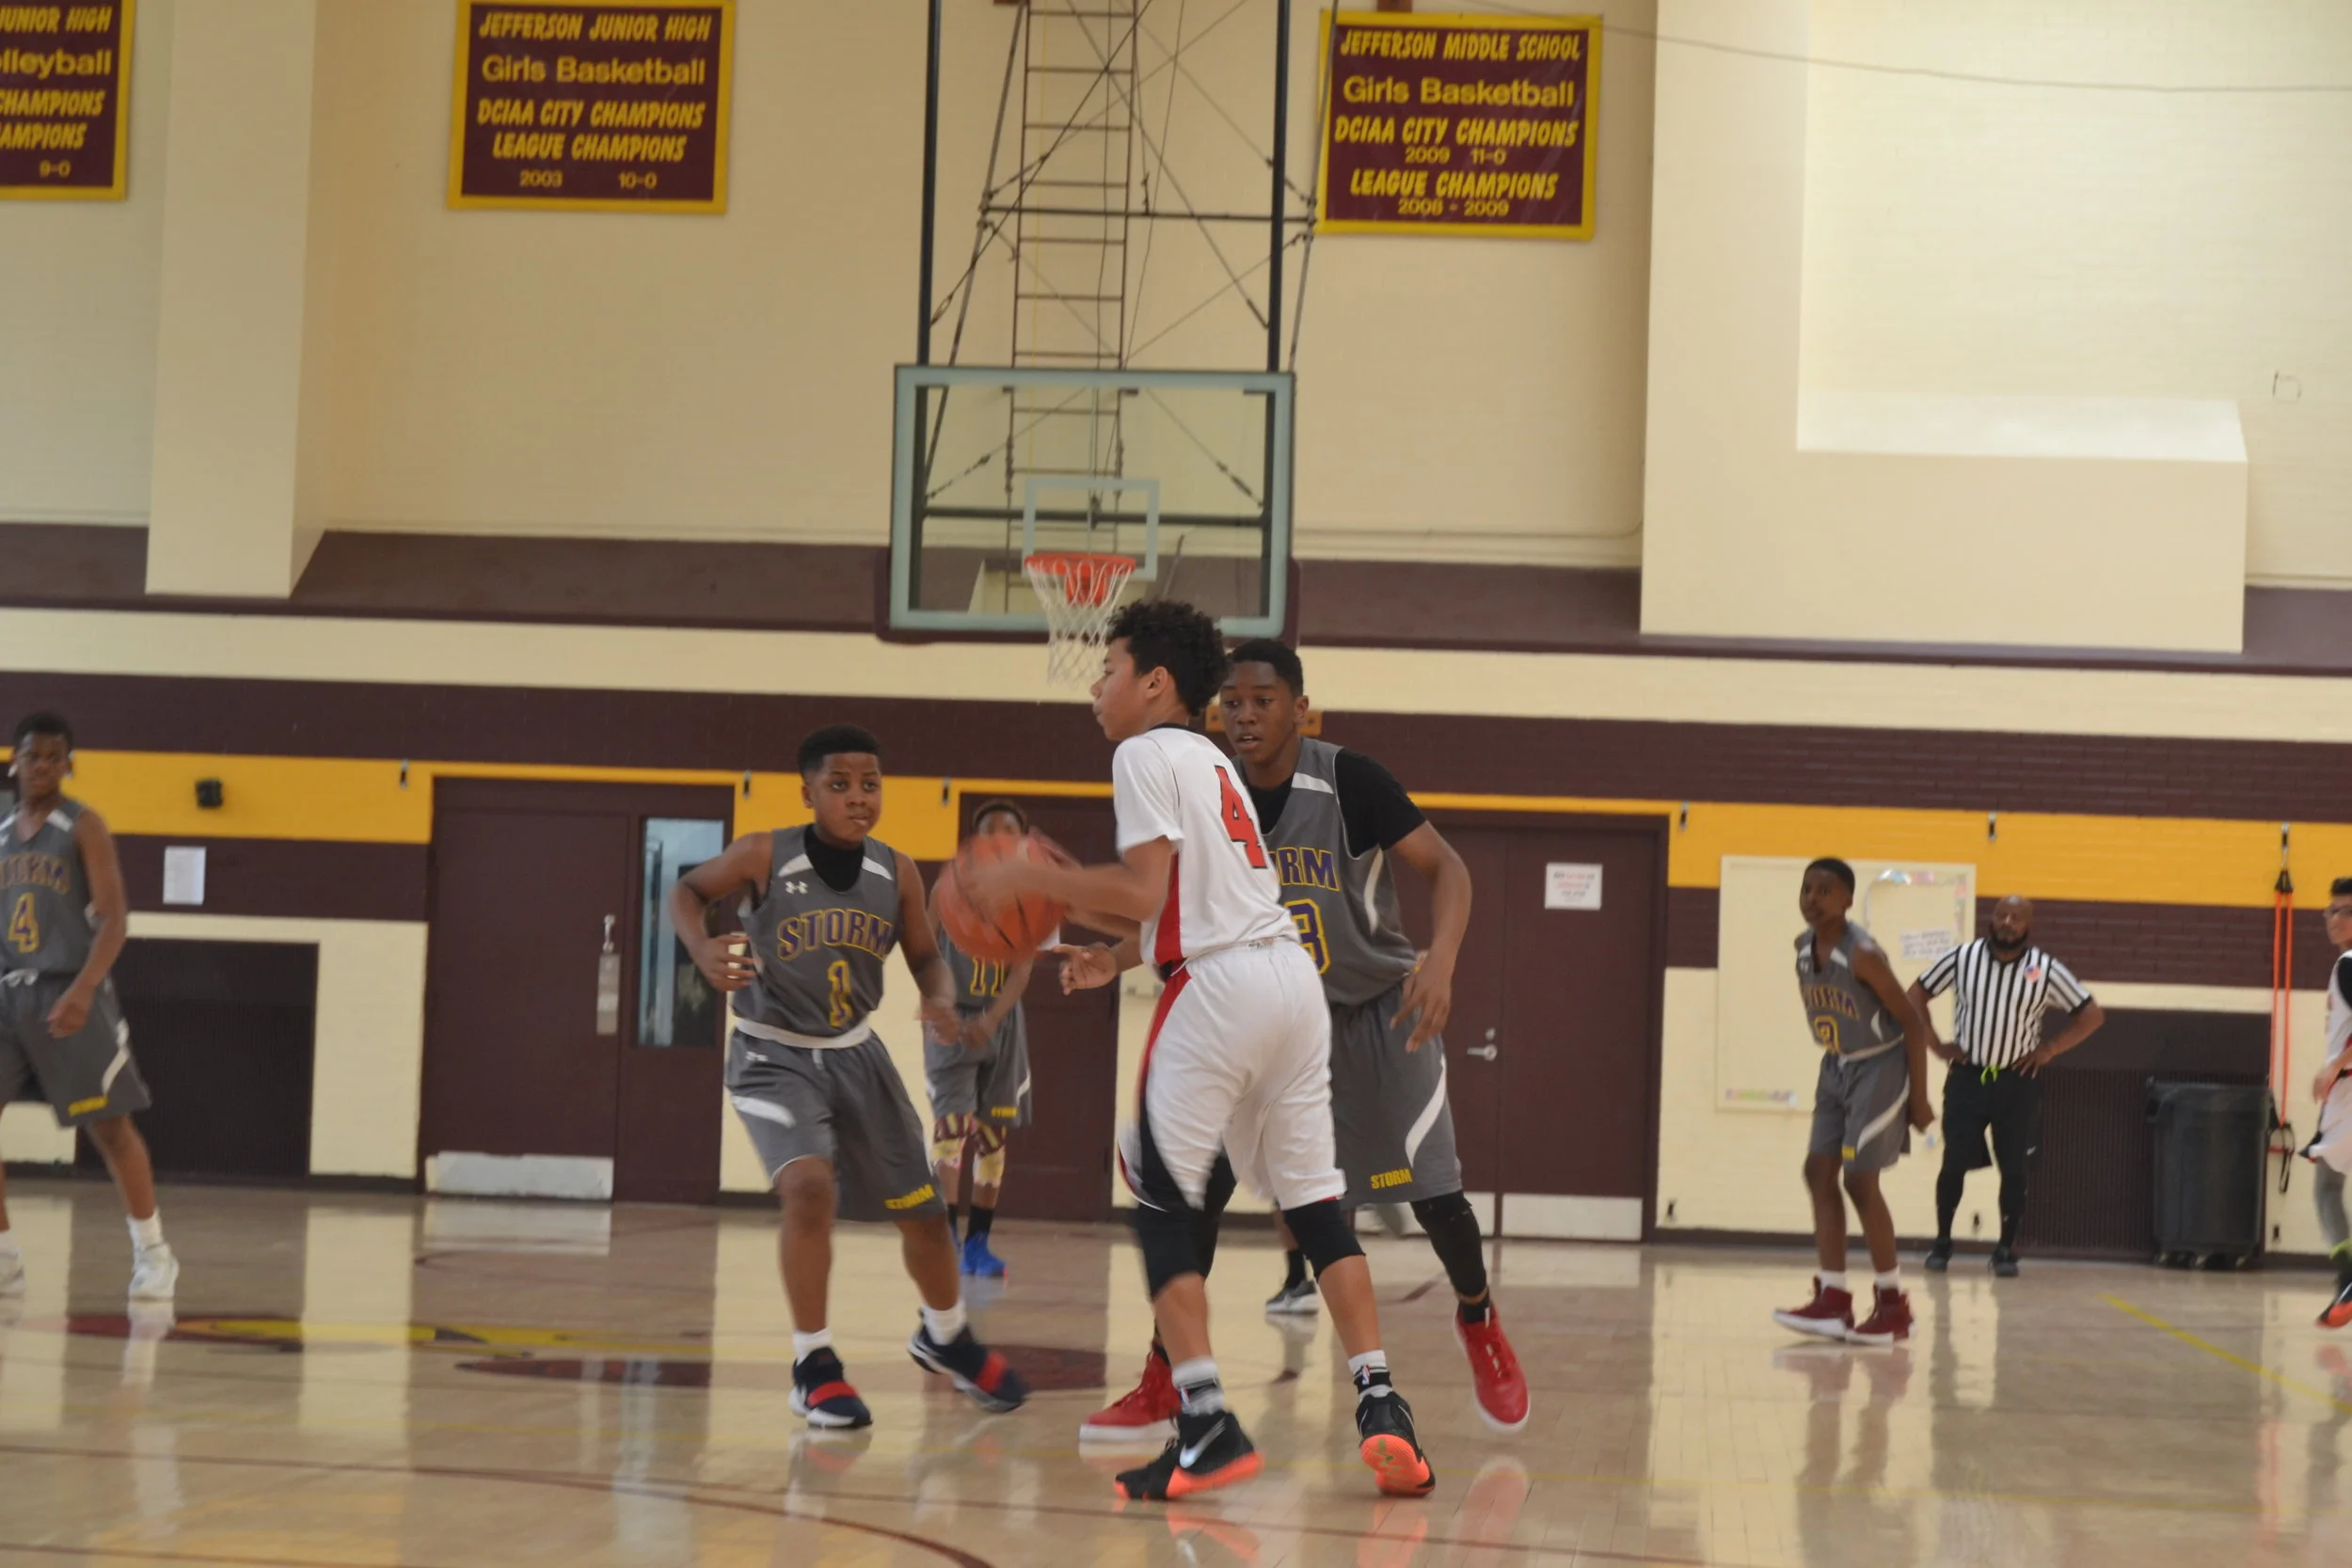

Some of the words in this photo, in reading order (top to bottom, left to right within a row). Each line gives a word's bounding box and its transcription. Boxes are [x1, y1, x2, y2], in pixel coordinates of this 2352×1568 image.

[66, 6, 113, 33] HIGH
[479, 12, 583, 40] JEFFERSON
[589, 14, 659, 42] JUNIOR
[664, 15, 712, 41] HIGH
[1340, 29, 1438, 59] JEFFERSON
[1442, 32, 1510, 60] MIDDLE
[1516, 34, 1581, 61] SCHOOL
[0, 47, 113, 80] lleyball
[482, 55, 546, 83] Girls
[556, 56, 706, 85] Basketball
[1343, 75, 1409, 103] Girls
[1421, 77, 1575, 107] Basketball
[477, 99, 534, 126] DCIAA
[540, 100, 585, 128] CITY
[590, 100, 706, 129] CHAMPIONS
[1334, 116, 1395, 143] DCIAA
[1402, 117, 1449, 145] CITY
[1455, 118, 1580, 147] CHAMPIONS
[492, 132, 566, 160] LEAGUE
[571, 134, 688, 163] CHAMPIONS
[1350, 168, 1428, 198] LEAGUE
[1436, 171, 1560, 199] CHAMPIONS
[1214, 765, 1268, 869] 4
[8, 892, 40, 953] 4
[777, 908, 894, 963] STORM
[828, 959, 853, 1027] 1
[1371, 1168, 1413, 1189] STORM
